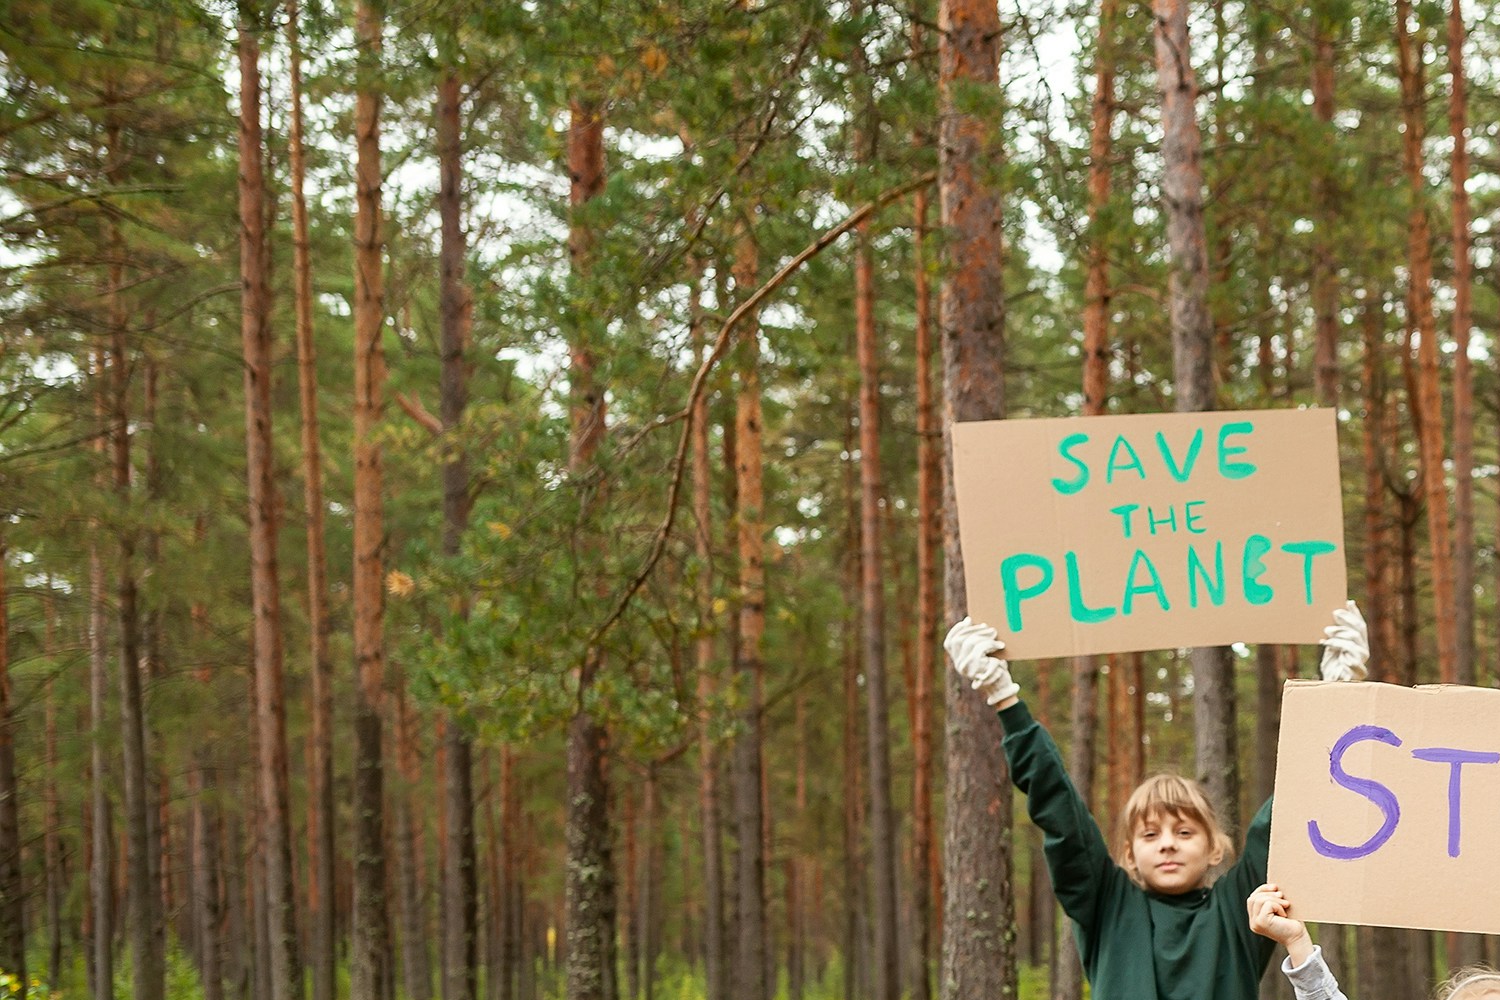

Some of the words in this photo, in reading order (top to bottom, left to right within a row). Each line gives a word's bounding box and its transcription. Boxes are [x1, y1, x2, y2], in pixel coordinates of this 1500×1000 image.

[1050, 421, 1258, 496] SAVE
[1109, 500, 1207, 539] THE
[1000, 533, 1337, 633] PLANET
